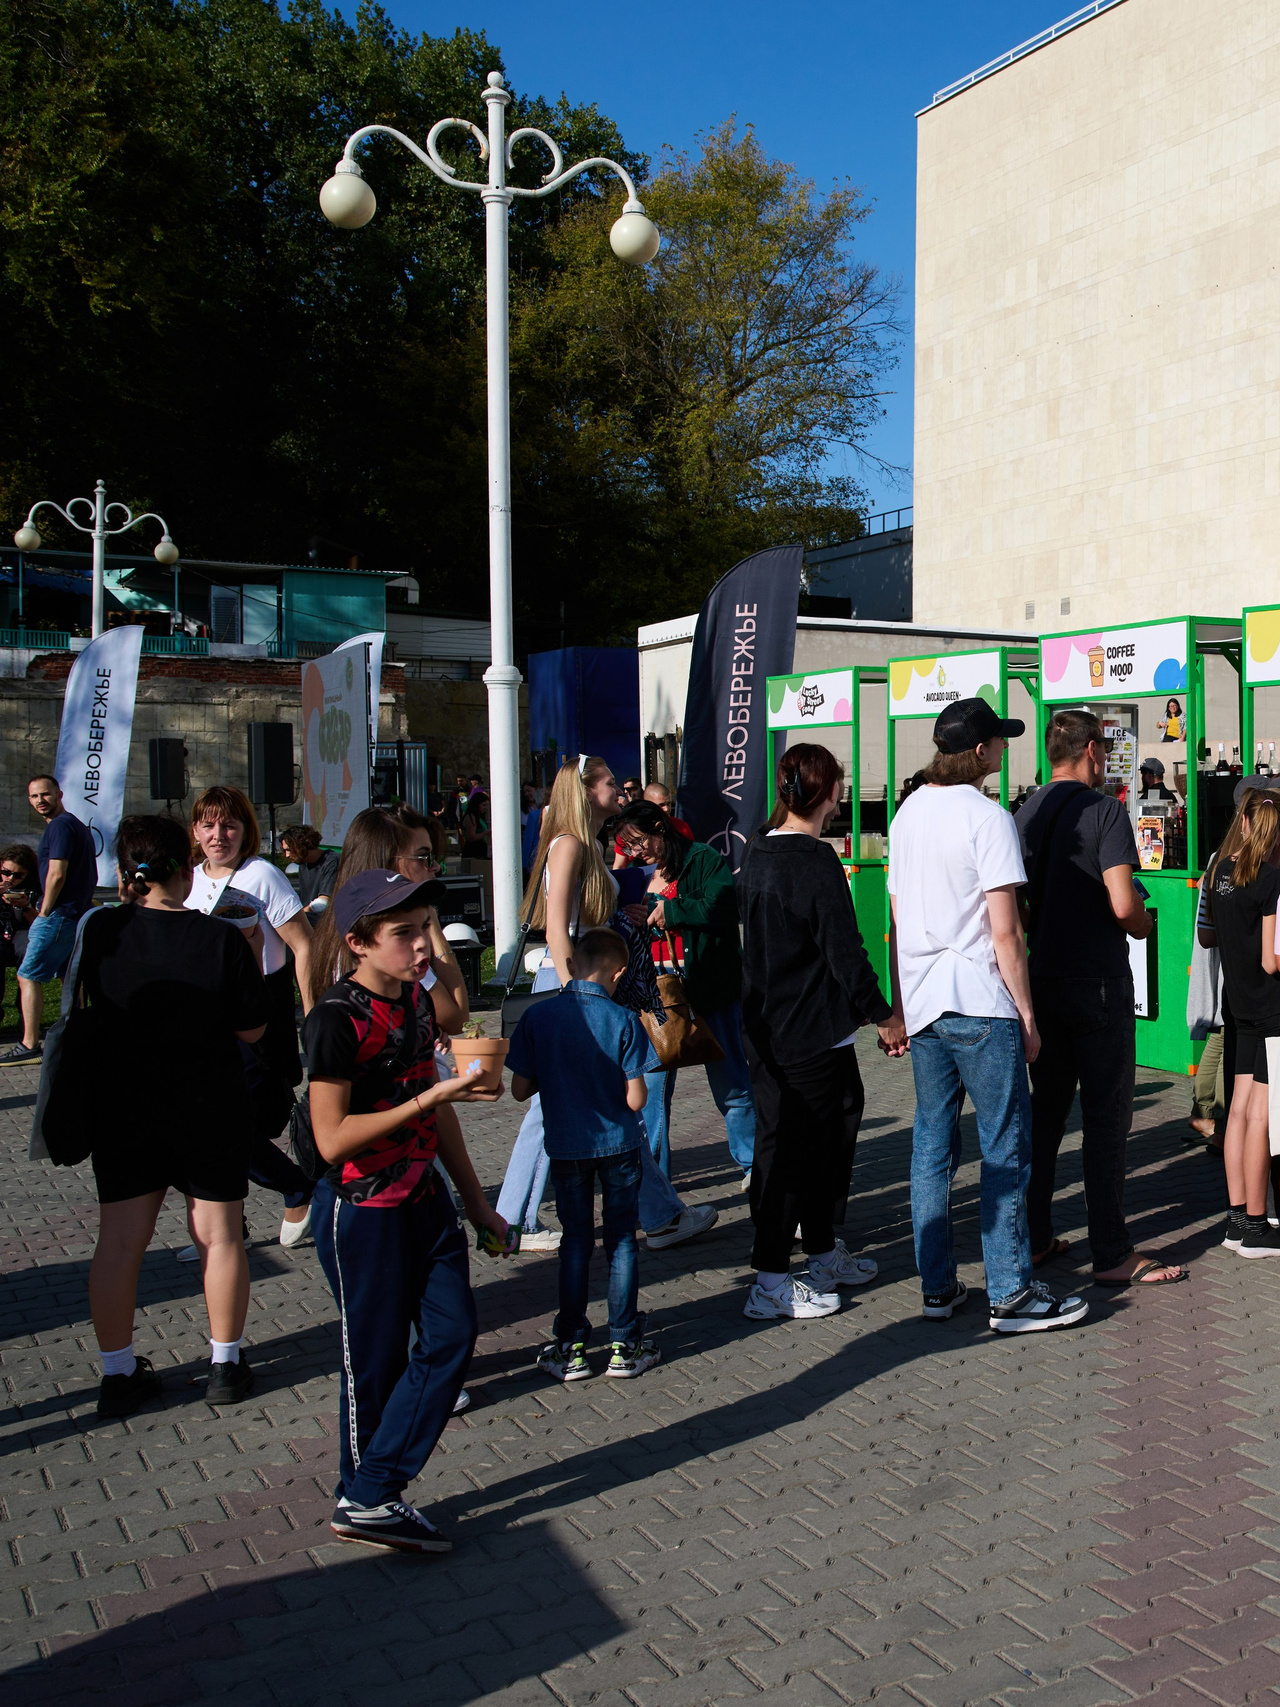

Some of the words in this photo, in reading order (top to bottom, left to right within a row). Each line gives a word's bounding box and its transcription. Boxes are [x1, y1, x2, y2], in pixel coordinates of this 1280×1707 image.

[1106, 643, 1136, 660] COFFEE
[1110, 662, 1133, 677] MOOD
[721, 603, 757, 801] ЛЕВОБЕРЕЖЬЕ
[945, 691, 959, 701] QUEEN
[84, 668, 112, 806] ЛЕВОБЕРЕЖЬЕ
[1112, 729, 1127, 737] ICE
